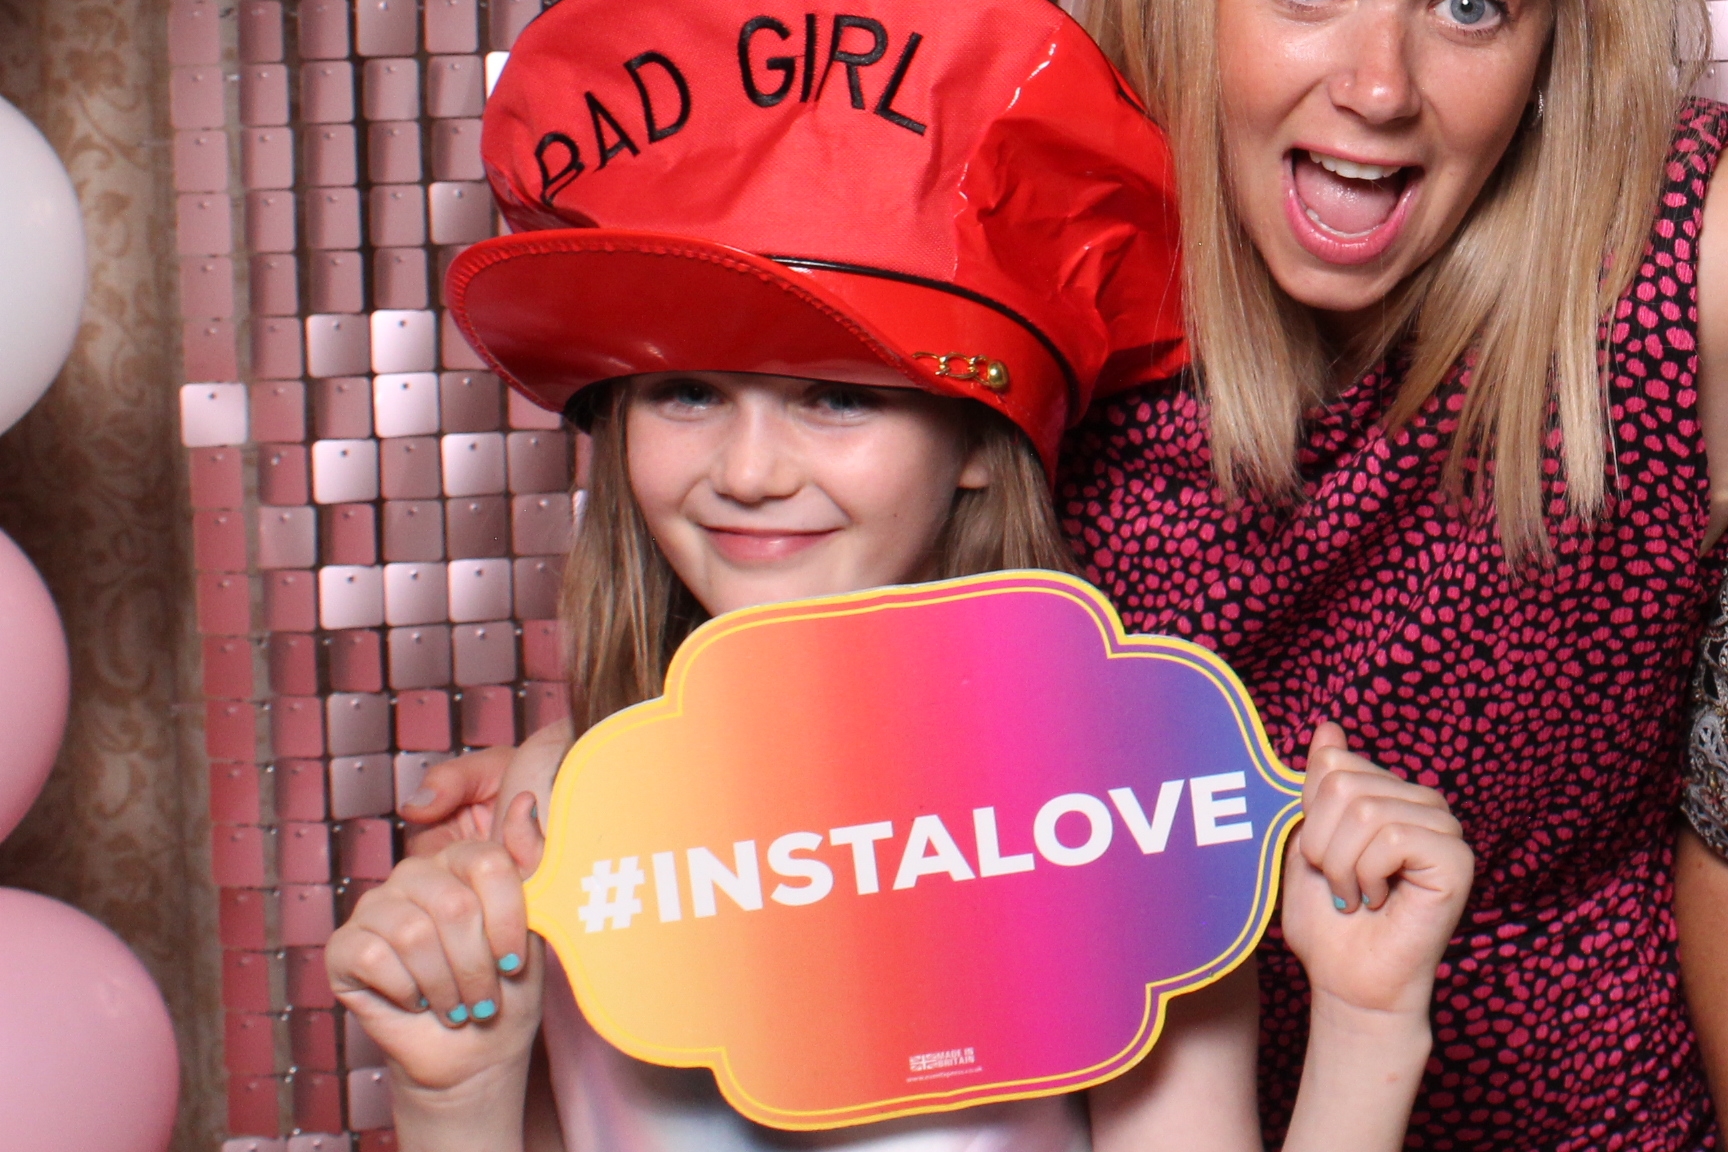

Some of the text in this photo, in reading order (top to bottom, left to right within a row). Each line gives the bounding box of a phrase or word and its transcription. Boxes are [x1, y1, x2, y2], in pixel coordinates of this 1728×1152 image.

[534, 13, 928, 207] BAD GIRL
[577, 770, 1254, 934] #INSTALOVE
